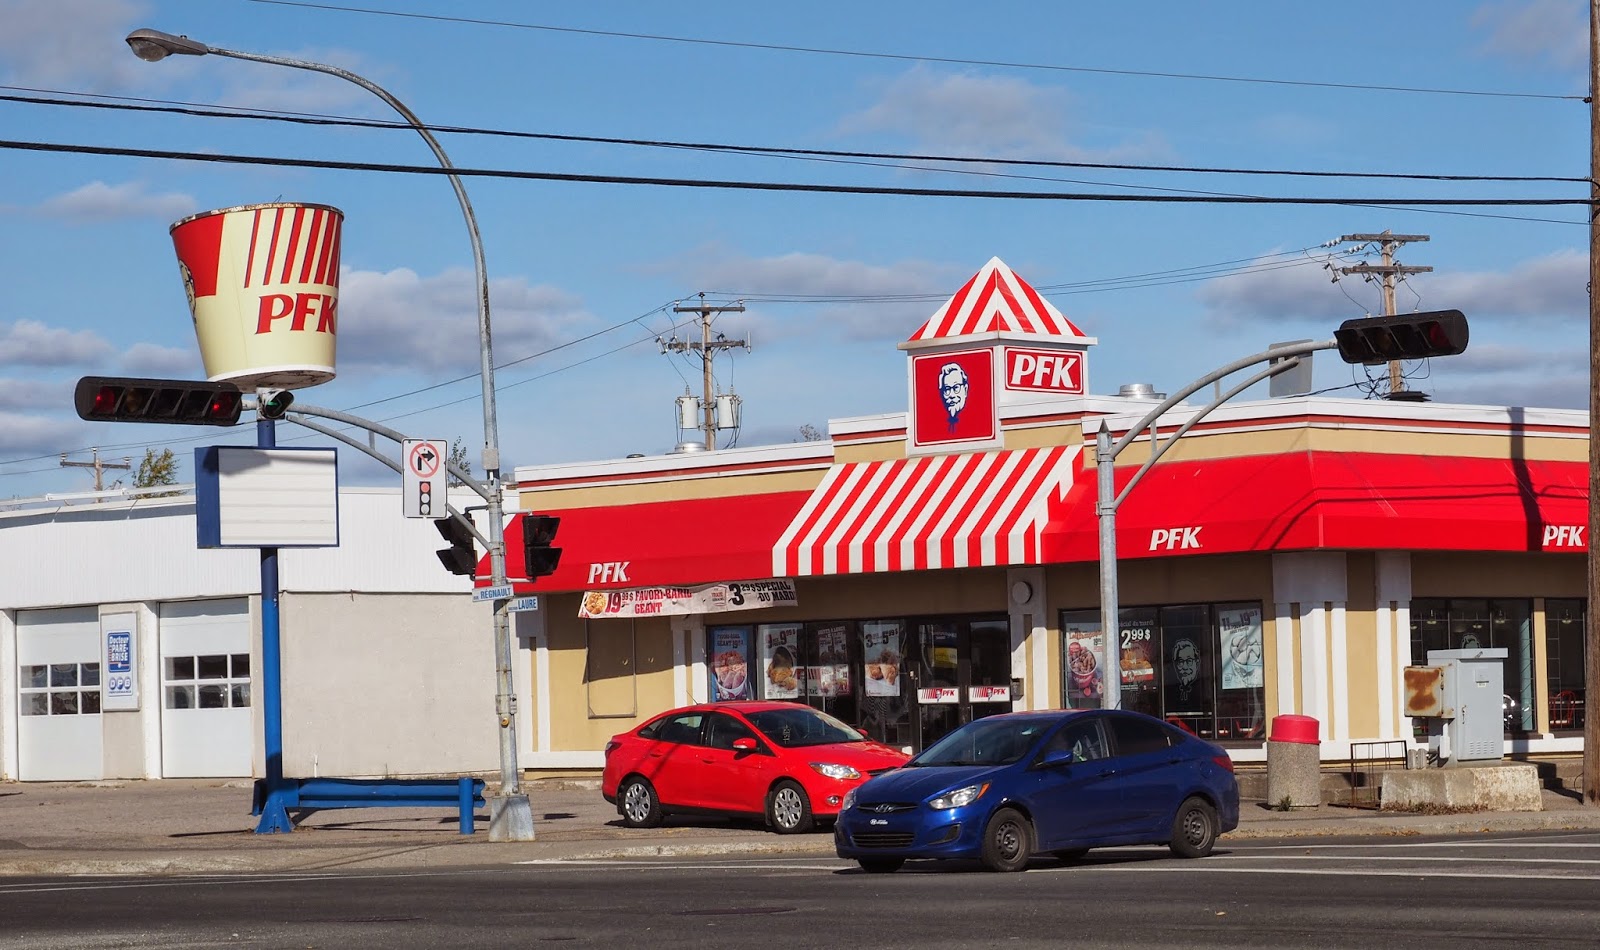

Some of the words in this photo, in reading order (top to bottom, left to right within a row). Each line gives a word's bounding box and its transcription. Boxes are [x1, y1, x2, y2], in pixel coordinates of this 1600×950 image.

[255, 293, 338, 335] PFK
[1010, 354, 1078, 389] PFK
[1148, 526, 1203, 551] PFK
[1542, 524, 1586, 547] PFK
[587, 561, 631, 584] PFK
[480, 587, 511, 599] RÉGNAULT
[759, 592, 770, 602] DU
[518, 598, 537, 610] LAURE
[942, 689, 955, 697] PFK
[992, 688, 1006, 696] PFK
